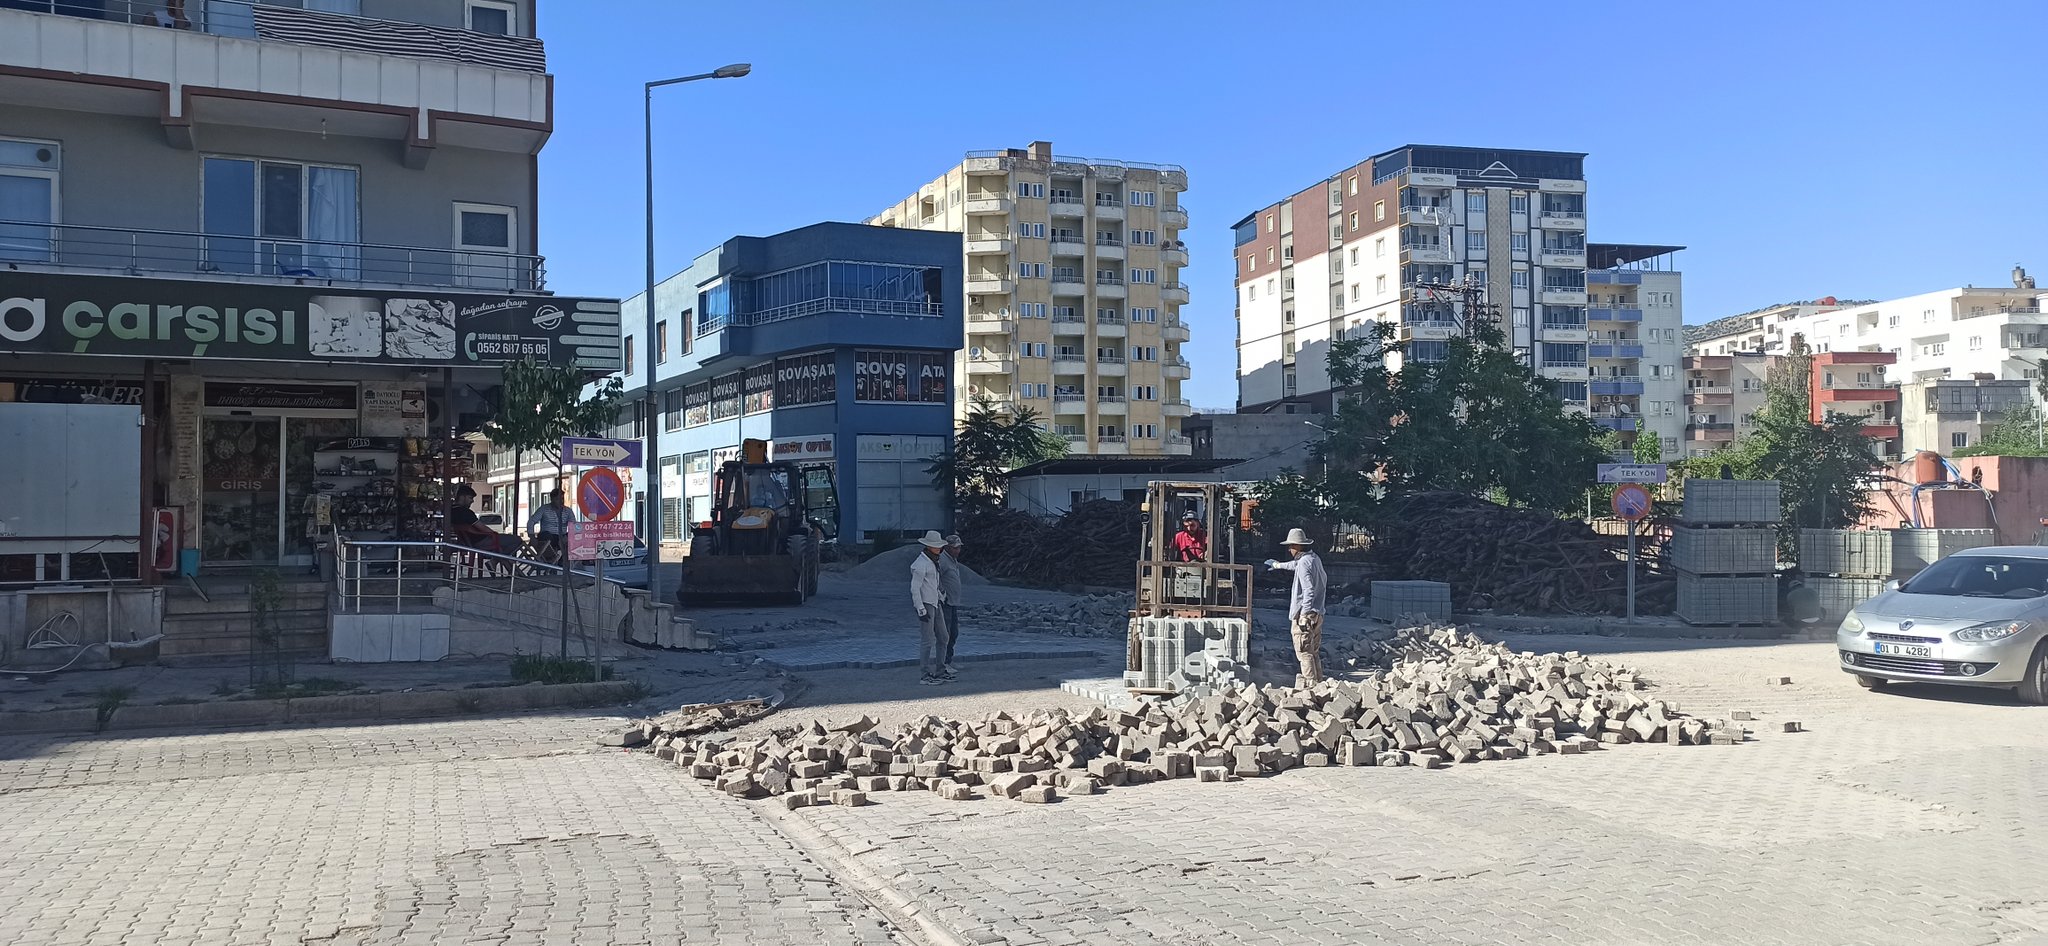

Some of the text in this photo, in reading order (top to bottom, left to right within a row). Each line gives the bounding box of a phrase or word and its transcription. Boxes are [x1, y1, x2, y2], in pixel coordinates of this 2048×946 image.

[460, 299, 528, 316] dağadan sofraya
[62, 299, 295, 356] çarşısı
[477, 332, 501, 341] SİPARİŞ
[477, 342, 501, 353] 0552
[522, 343, 534, 354] 65
[536, 343, 547, 355] 05
[777, 363, 836, 382] ROVAŞATA
[855, 360, 907, 379] ROVŞ
[574, 446, 615, 458] TEK YÖN
[1621, 469, 1636, 477] TEK
[220, 479, 262, 491] GİRİŞ
[1880, 644, 1929, 657] 01 D 4282
